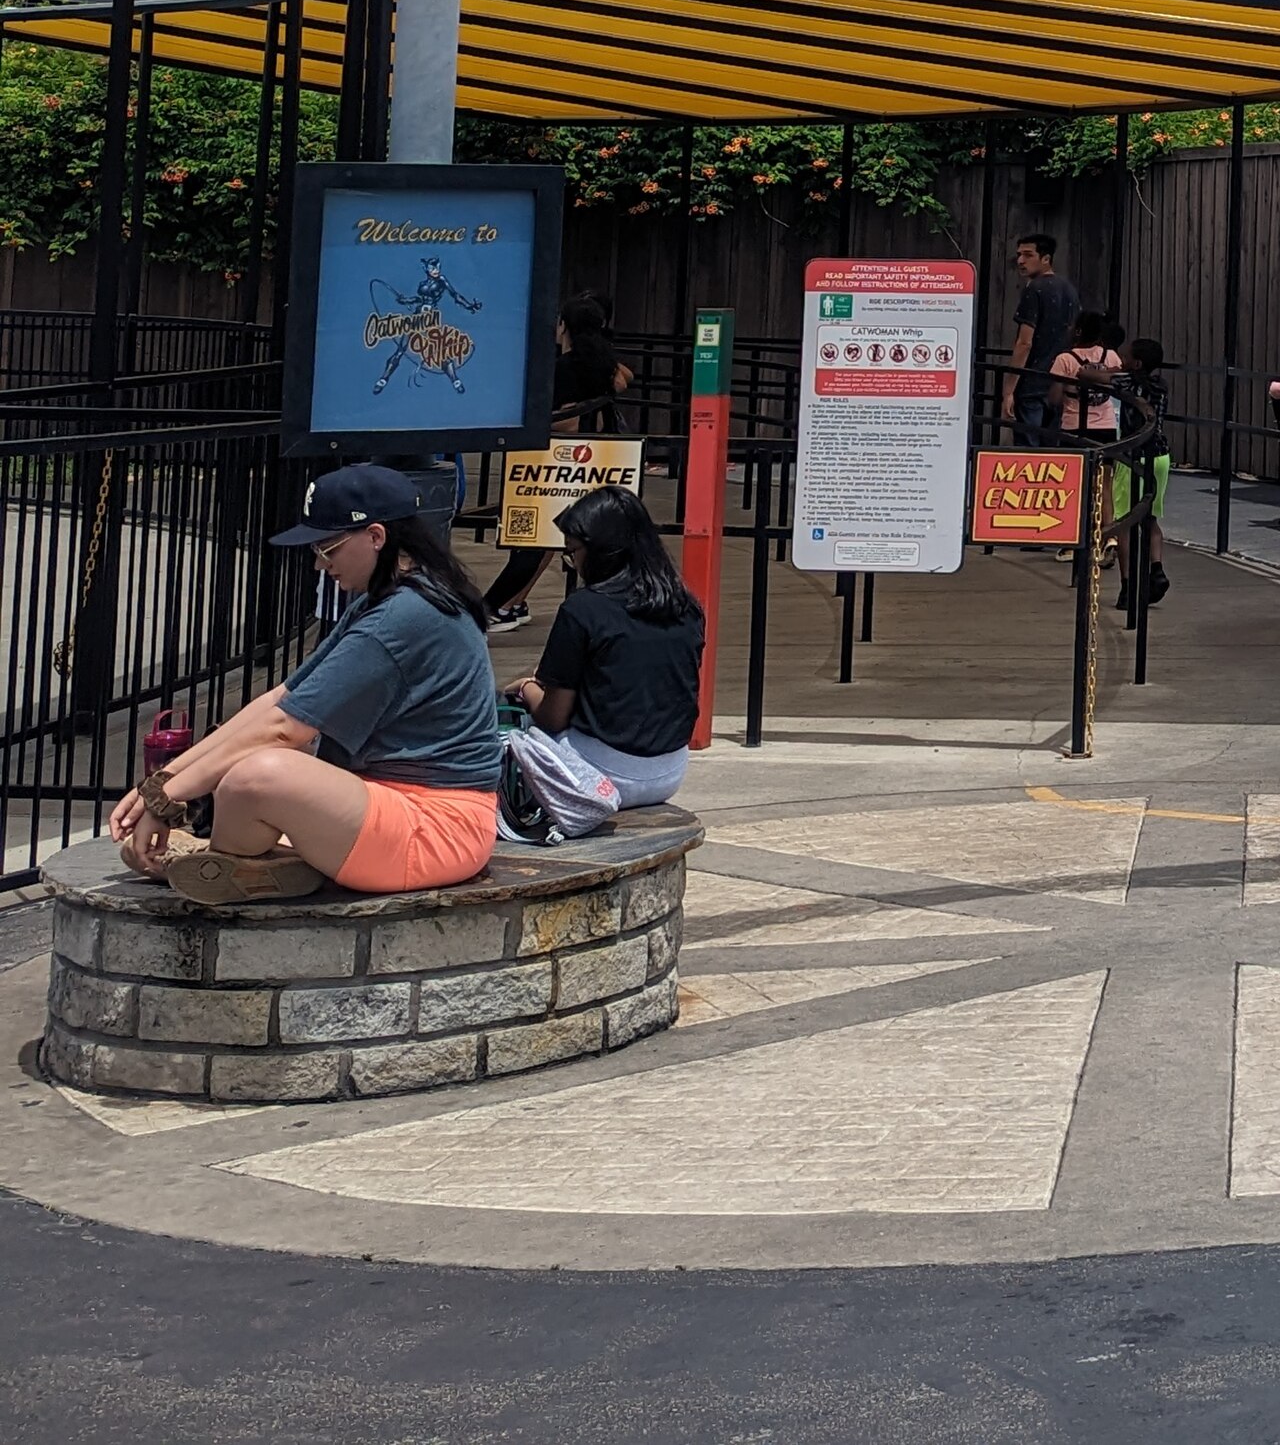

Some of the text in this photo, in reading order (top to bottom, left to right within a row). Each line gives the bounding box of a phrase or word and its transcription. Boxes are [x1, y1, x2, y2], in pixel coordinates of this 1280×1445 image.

[356, 218, 498, 244] Welcome to
[825, 272, 844, 280] READ
[889, 265, 903, 273] ALL
[903, 265, 929, 274] GUESTS
[831, 280, 860, 288] FOLLOW
[365, 310, 441, 349] Catwoman
[851, 327, 924, 338] CATWOMAN Whip
[409, 325, 472, 368] Whip
[508, 464, 637, 485] ENTRANCE
[992, 461, 1068, 483] MAIN
[515, 485, 589, 498] Catwoman
[983, 487, 1075, 510] ENTRY
